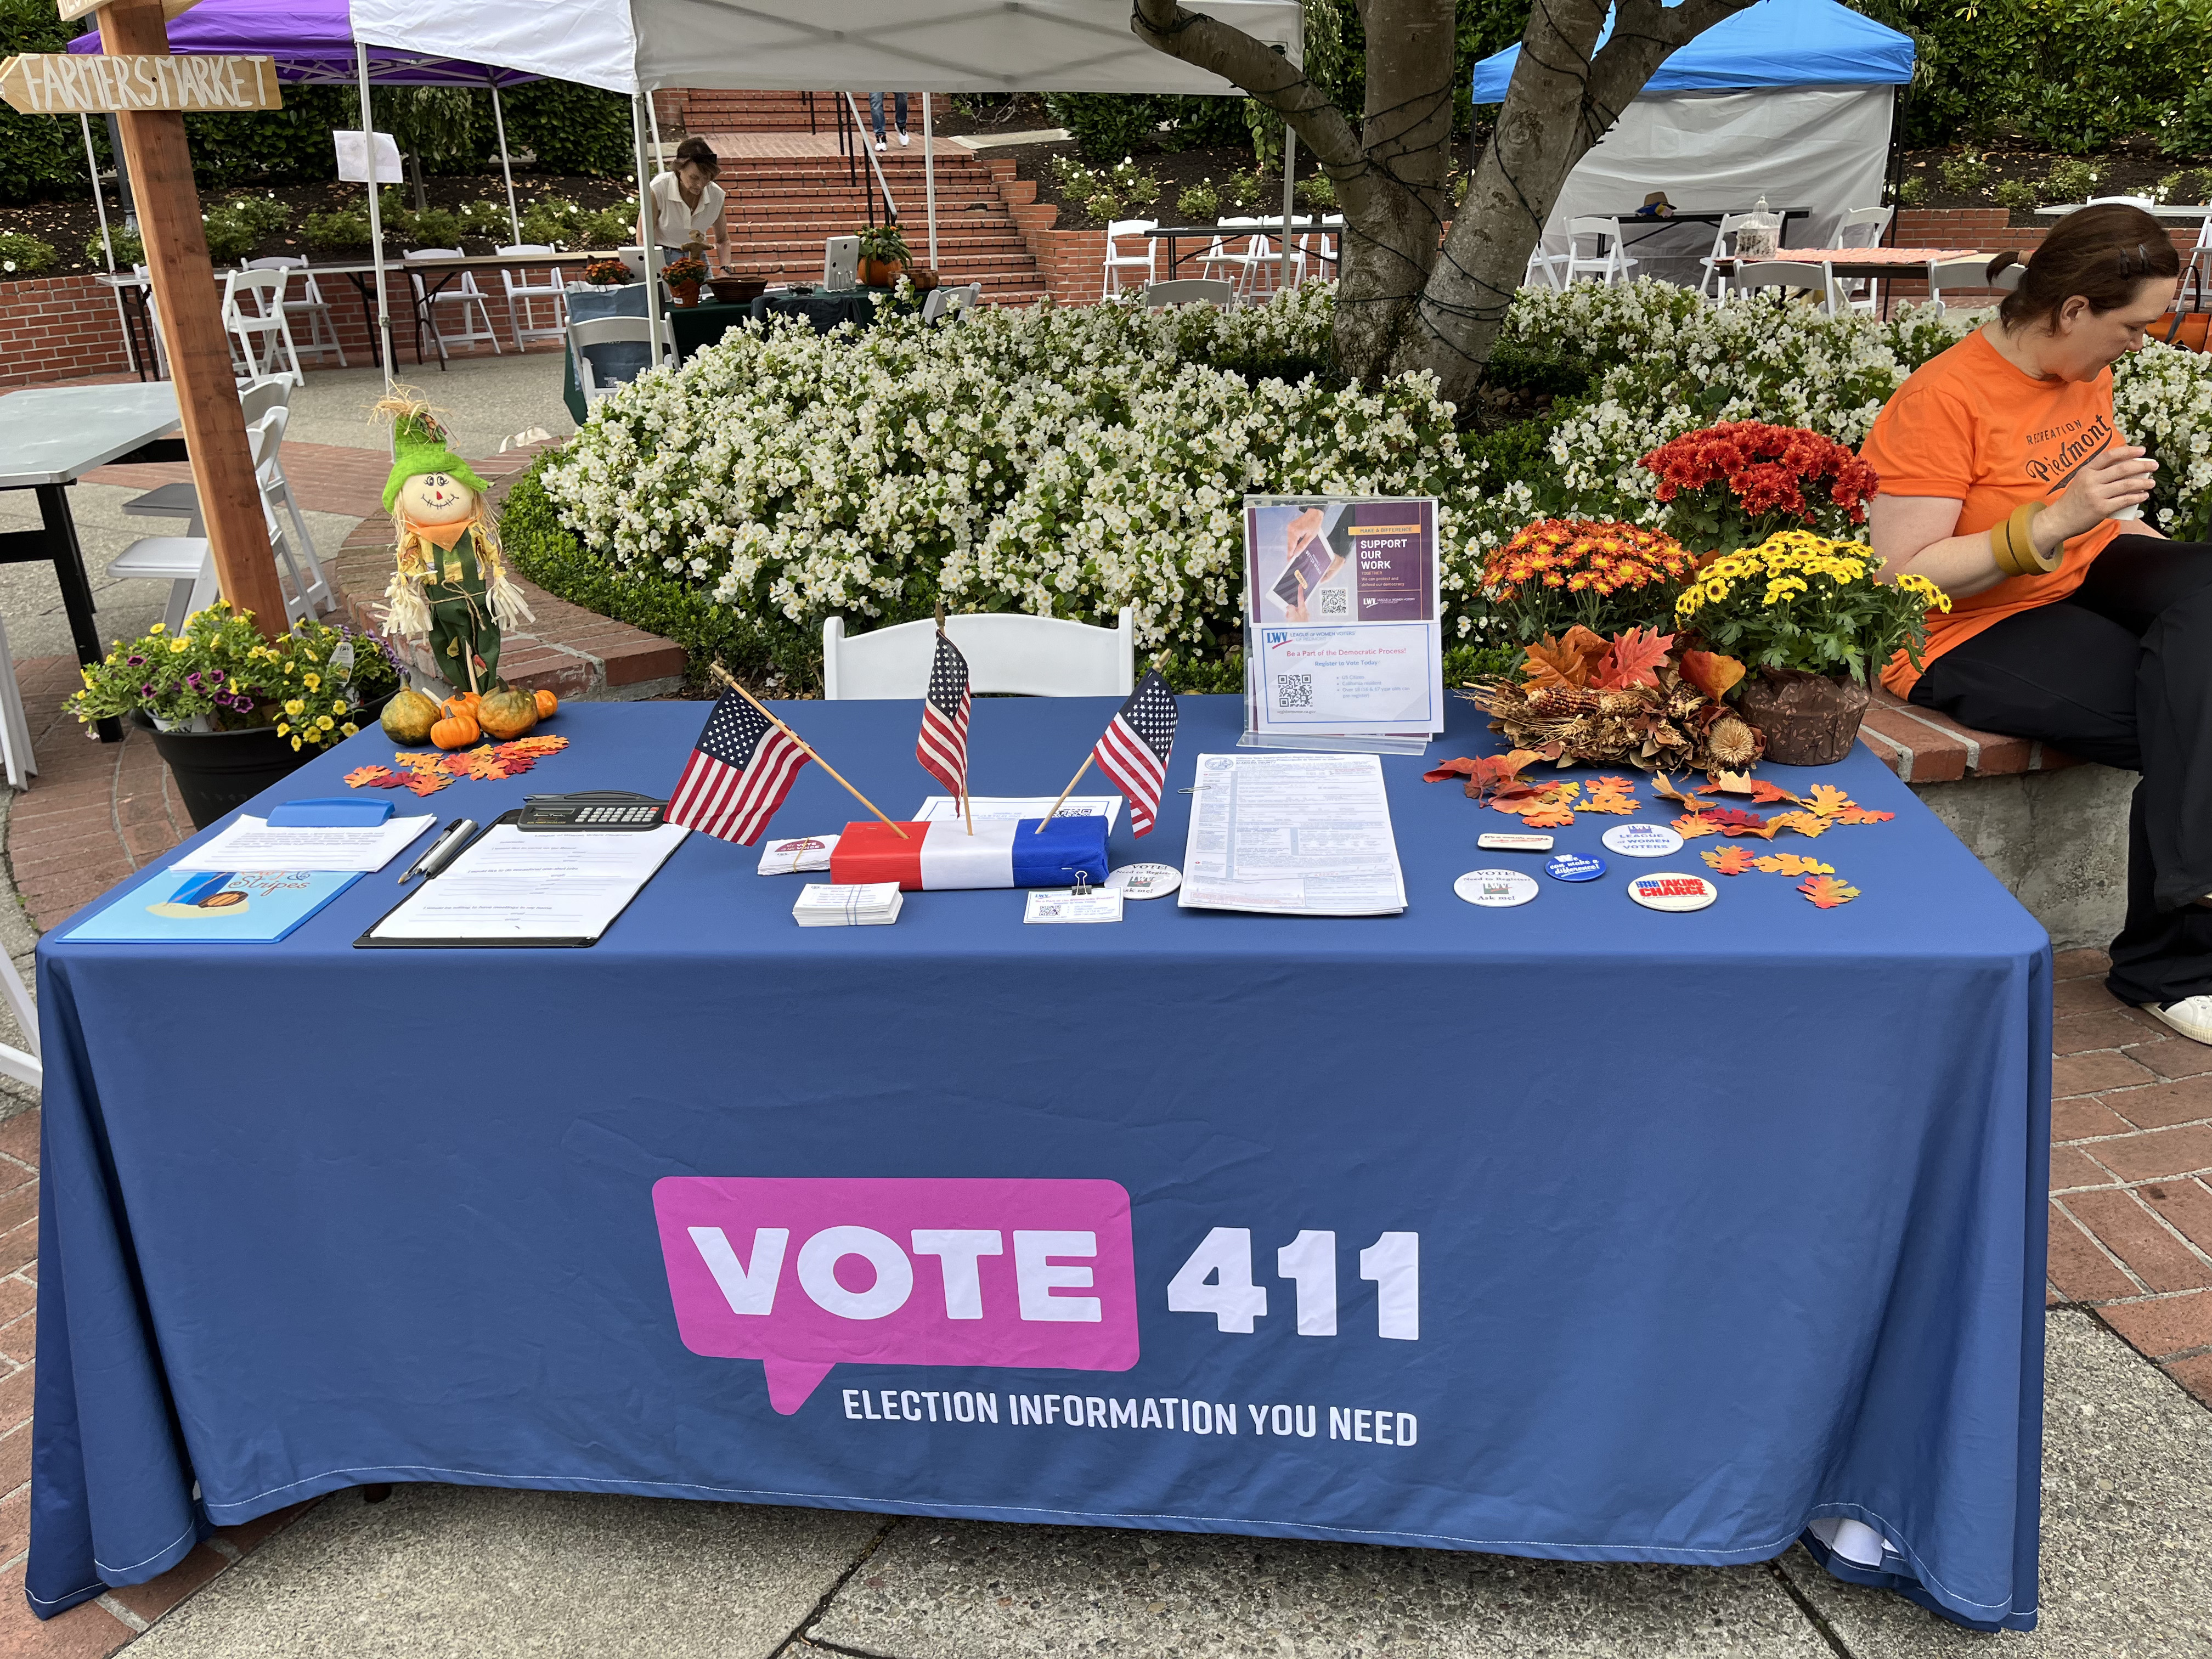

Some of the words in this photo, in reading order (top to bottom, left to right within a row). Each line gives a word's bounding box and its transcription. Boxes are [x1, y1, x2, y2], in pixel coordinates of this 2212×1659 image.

[20, 54, 157, 110] FARMER'S
[155, 55, 268, 108] MARKET
[2026, 419, 2083, 445] RECREATION
[2025, 414, 2112, 482] Piedmont
[1360, 539, 1408, 549] SUPPORT
[1306, 550, 1315, 564] BETTER
[1361, 550, 1381, 559] OUR
[1361, 561, 1391, 569] WORK
[1266, 632, 1288, 643] LWV
[1554, 854, 1579, 863] We
[1555, 863, 1600, 874] difference!
[228, 876, 311, 896] Stripes
[1658, 878, 1703, 887] TAKING
[1639, 886, 1708, 897] CHARGE
[687, 1226, 1102, 1322] VOTE
[1167, 1227, 1419, 1340] 411
[843, 1390, 998, 1424] ELECTION
[1009, 1395, 1236, 1435] INFORMATION
[1249, 1404, 1316, 1437] YOU
[1330, 1407, 1417, 1446] NEED
